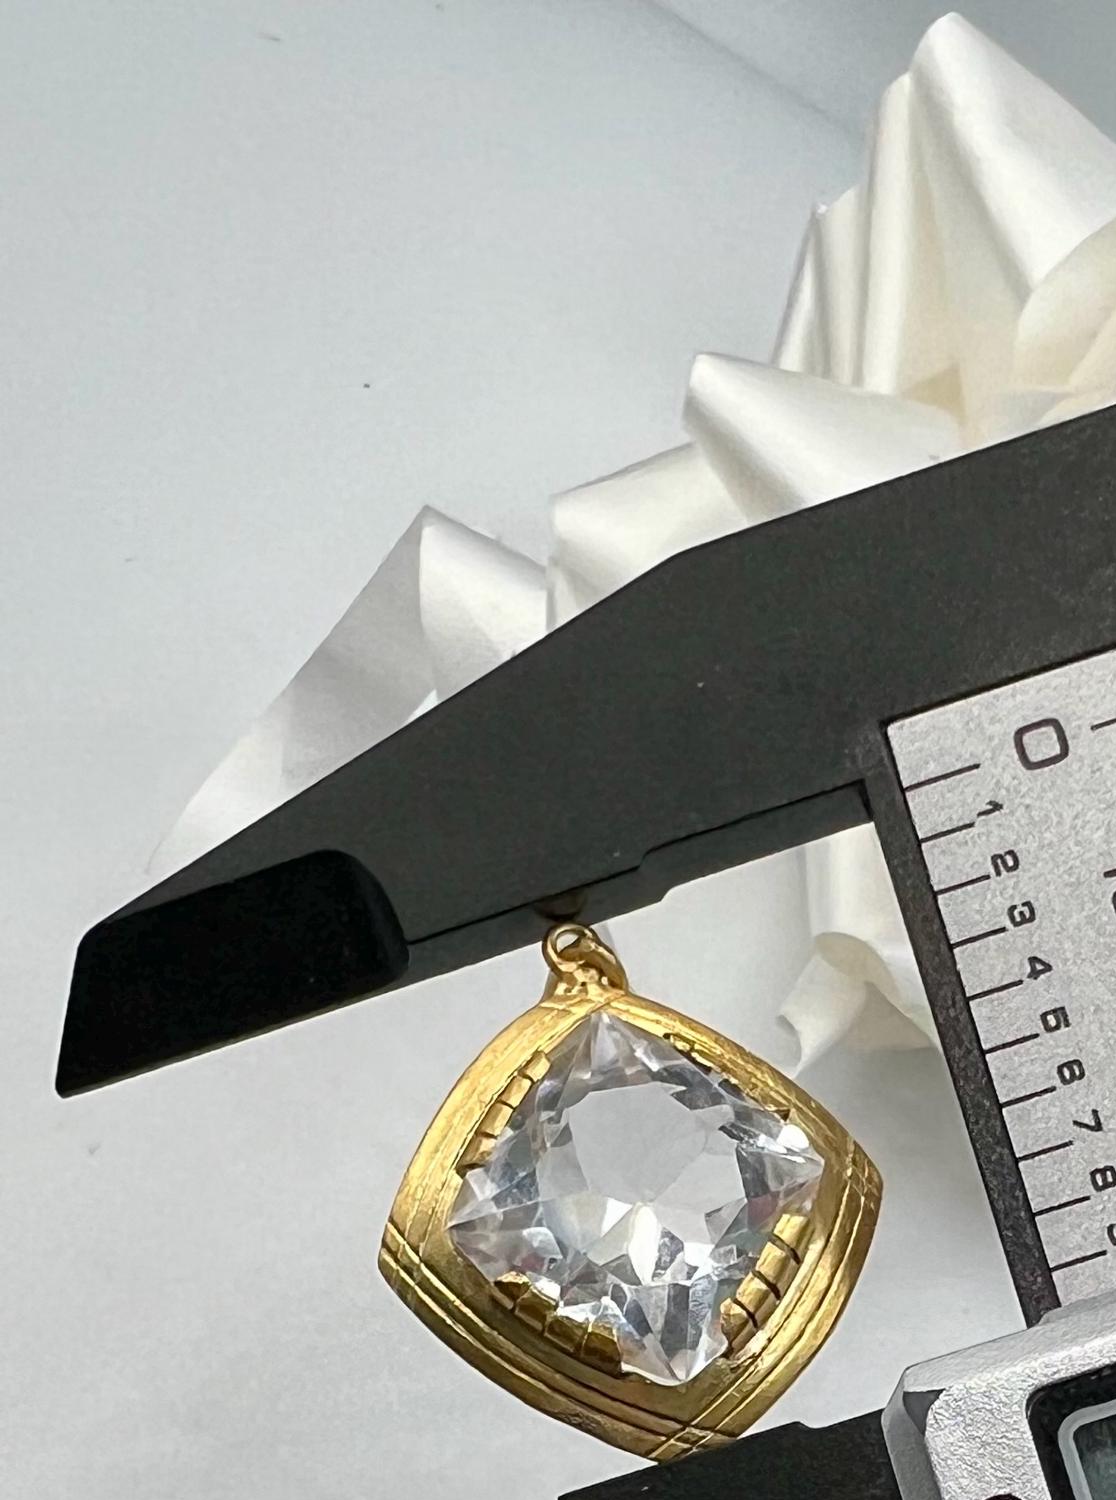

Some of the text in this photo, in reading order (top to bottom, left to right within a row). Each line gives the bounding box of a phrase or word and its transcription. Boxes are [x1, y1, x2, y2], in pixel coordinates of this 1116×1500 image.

[1014, 718, 1069, 770] 0
[975, 799, 1004, 817] 1
[989, 847, 1021, 878] 2
[1006, 900, 1037, 927] 3
[1025, 955, 1053, 982] 4
[1039, 1005, 1072, 1033] 5
[1071, 1108, 1103, 1134] 7
